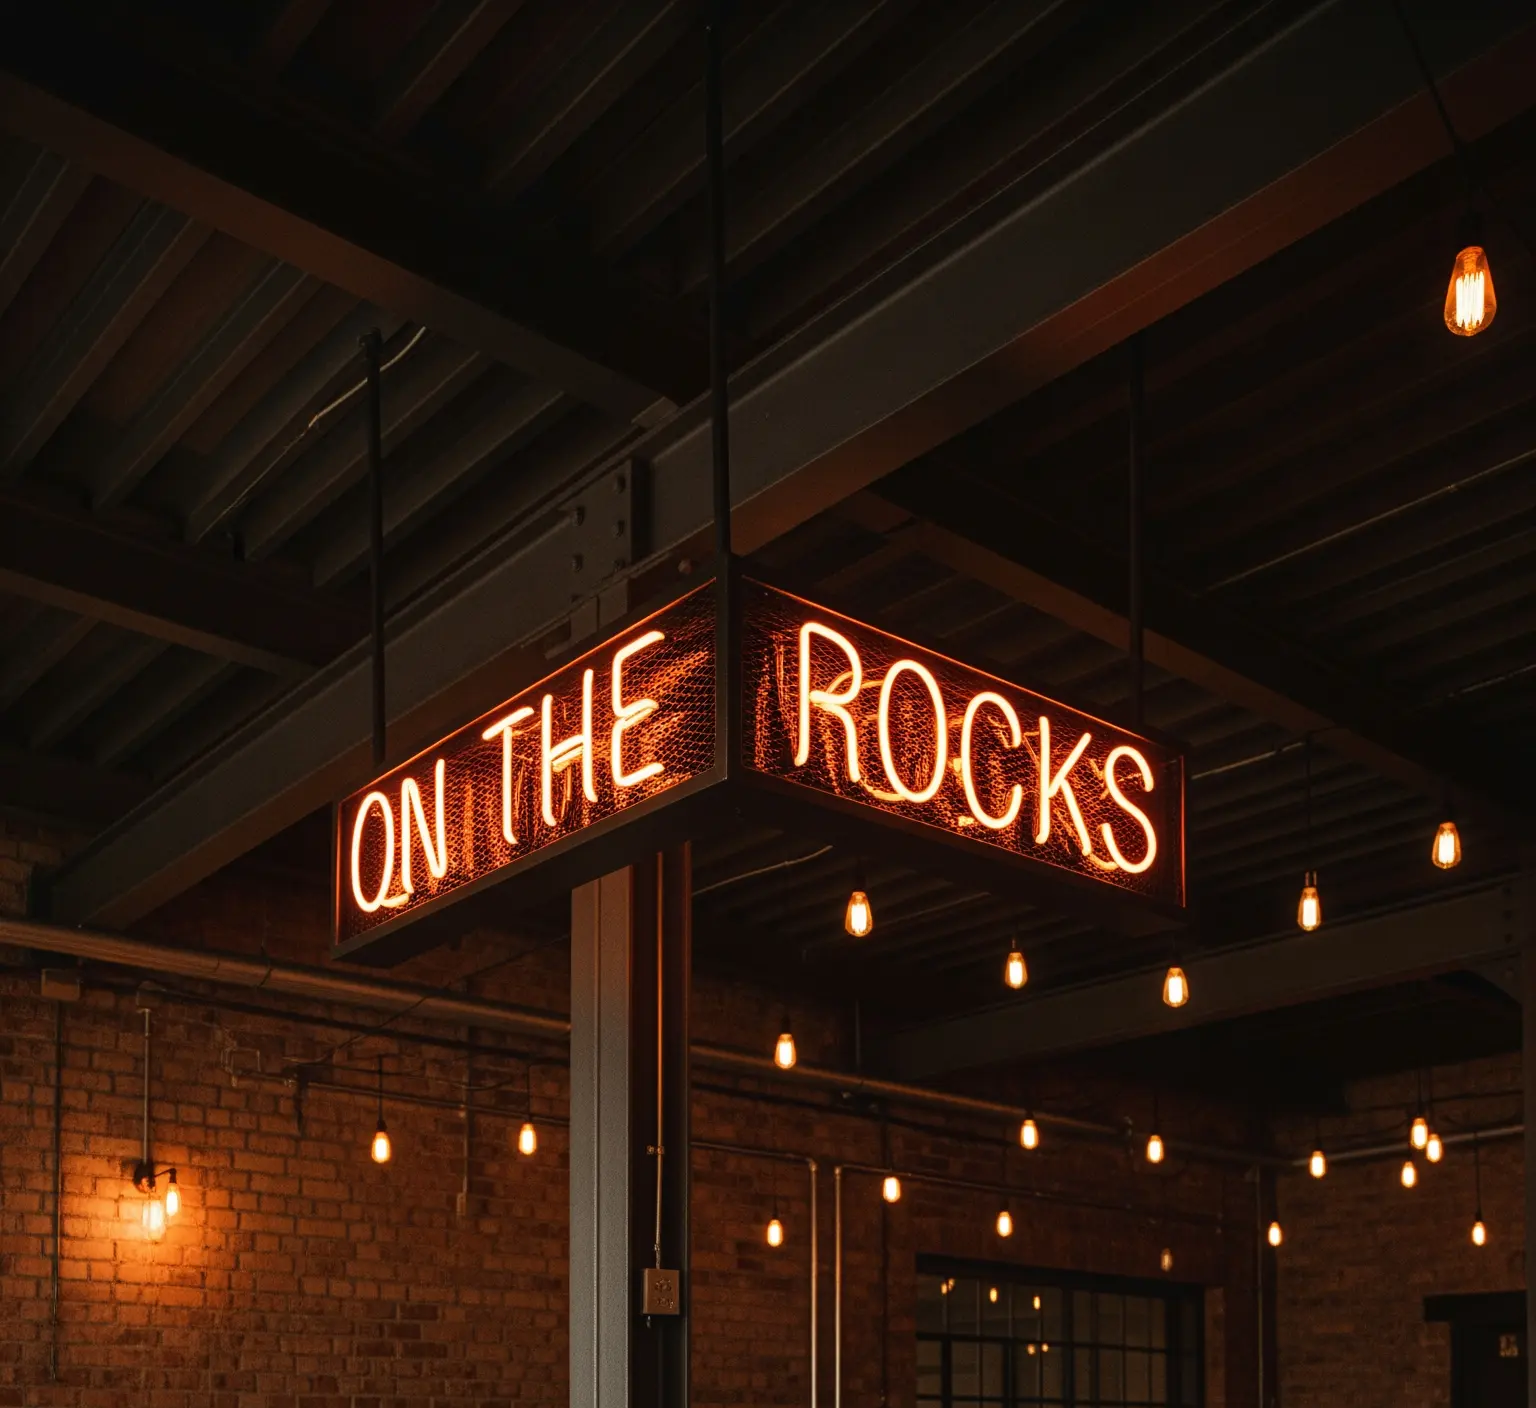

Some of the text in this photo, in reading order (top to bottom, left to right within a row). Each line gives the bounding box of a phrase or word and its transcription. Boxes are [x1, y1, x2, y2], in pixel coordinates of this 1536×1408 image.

[351, 630, 666, 913] ON THE
[795, 621, 1157, 874] ROCKS
